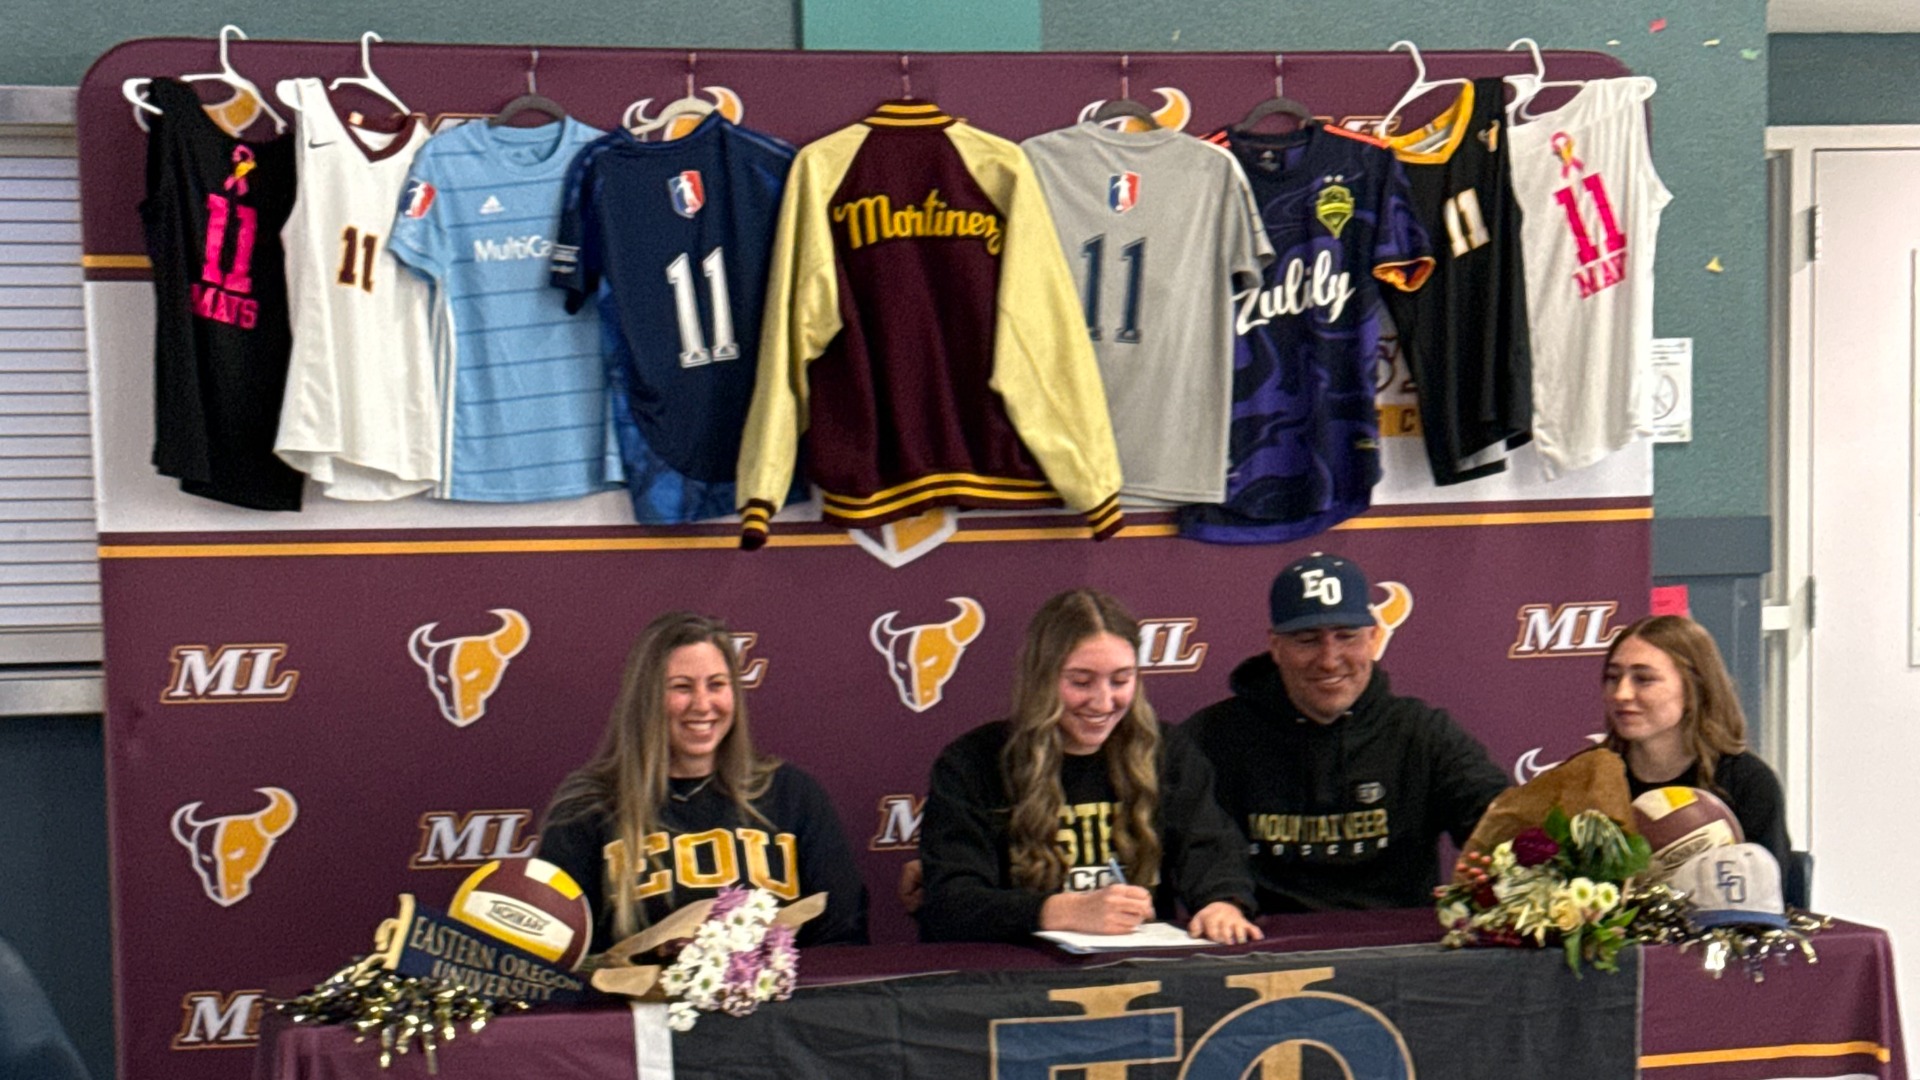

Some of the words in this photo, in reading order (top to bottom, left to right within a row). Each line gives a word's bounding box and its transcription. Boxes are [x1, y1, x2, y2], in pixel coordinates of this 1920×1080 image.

[202, 193, 258, 293] 11
[833, 190, 1003, 255] Martinez
[1443, 187, 1491, 258] 11
[1553, 173, 1627, 266] 11
[336, 226, 379, 294] 11
[1080, 234, 1147, 344] 11
[1230, 249, 1356, 336] Zulily
[666, 247, 741, 369] 11
[1300, 569, 1342, 606] EO
[1511, 602, 1625, 658] ML
[163, 645, 297, 702] ML
[411, 811, 538, 868] ML
[870, 795, 926, 850] M
[603, 828, 800, 901] EOU
[1716, 860, 1746, 903] EO
[1716, 860, 1746, 903] EASTERN
[174, 989, 263, 1050] M
